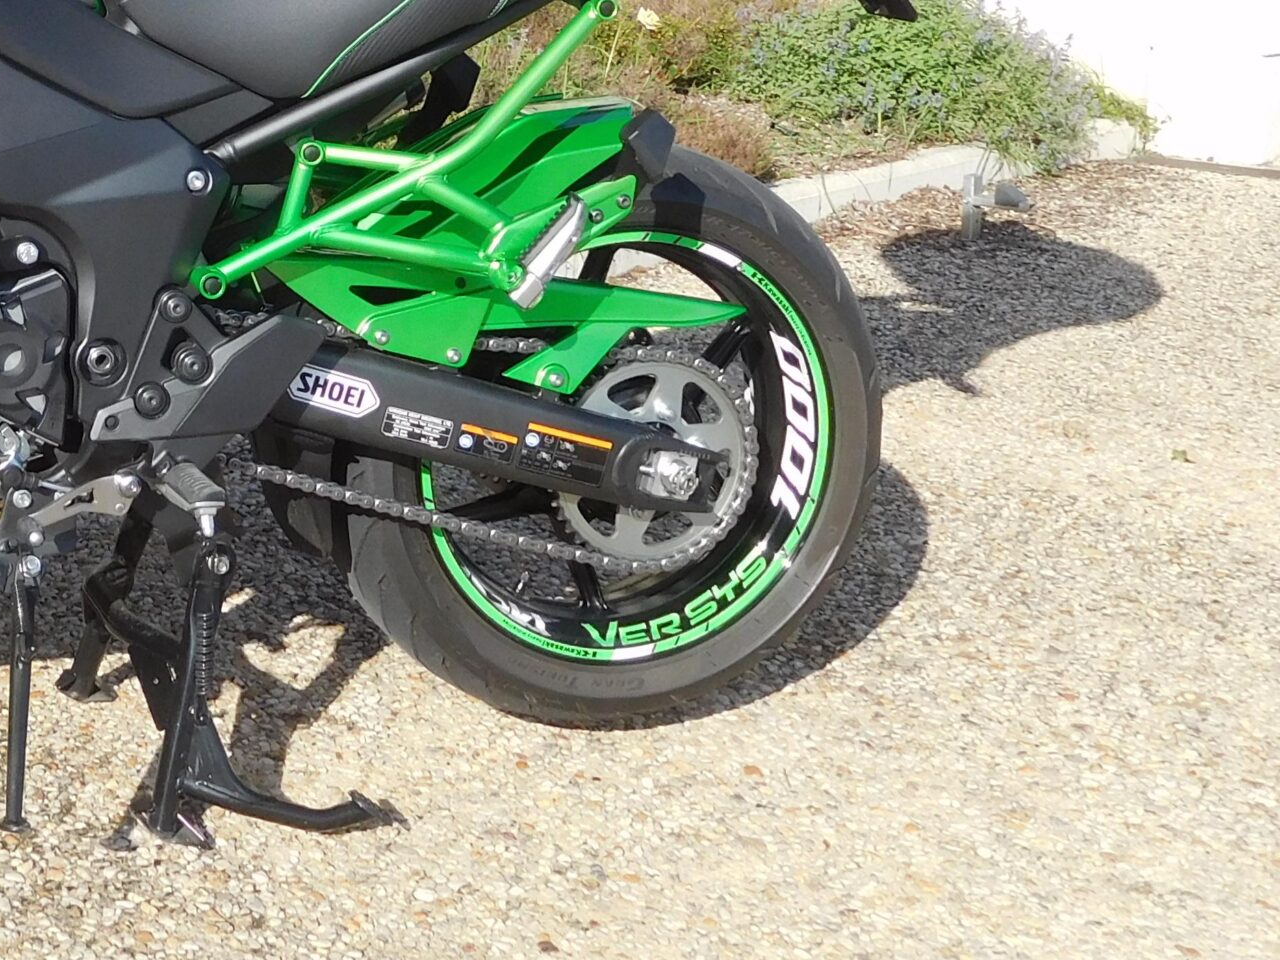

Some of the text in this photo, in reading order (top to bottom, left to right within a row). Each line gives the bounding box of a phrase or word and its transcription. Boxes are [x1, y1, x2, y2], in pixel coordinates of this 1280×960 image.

[297, 372, 366, 408] SHOEI
[769, 331, 815, 520] 1000
[581, 555, 768, 647] VERSYS
